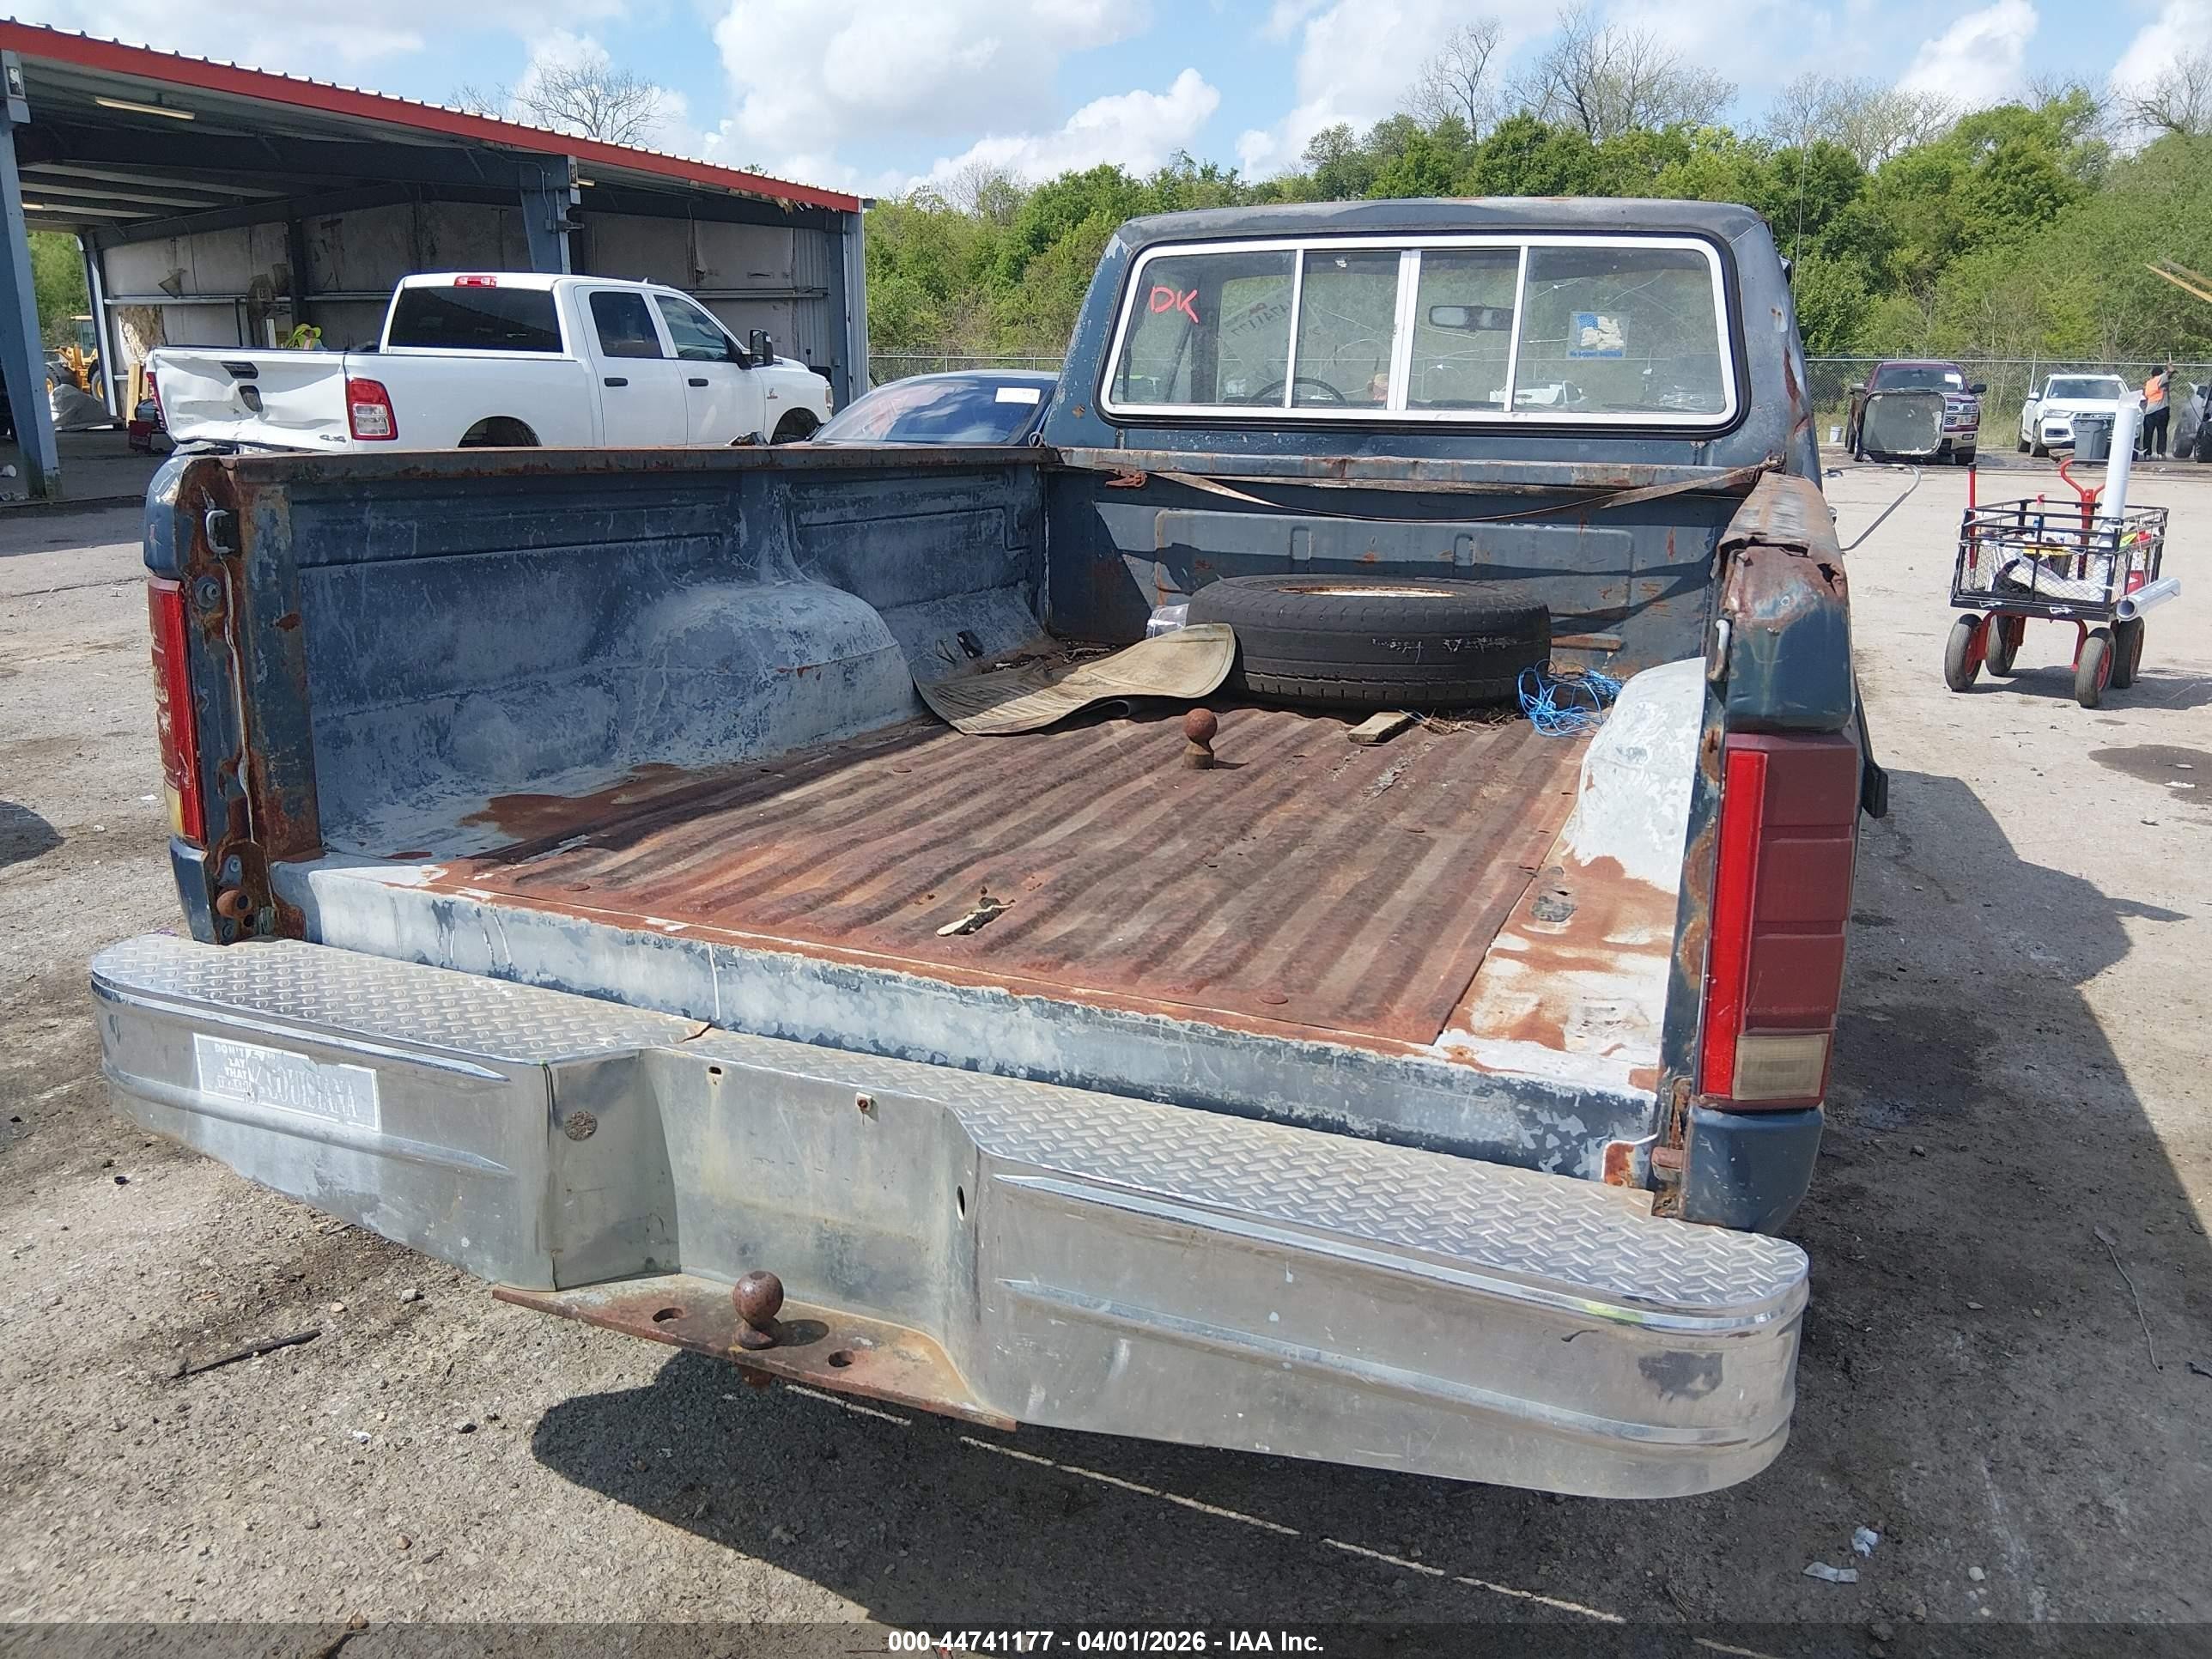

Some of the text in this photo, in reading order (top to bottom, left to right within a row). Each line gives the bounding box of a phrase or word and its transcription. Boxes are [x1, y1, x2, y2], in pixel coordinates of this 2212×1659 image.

[1151, 286, 1199, 324] DK
[214, 1042, 245, 1058] DON'T
[227, 1057, 245, 1068] LAY
[224, 1066, 247, 1080] THAT
